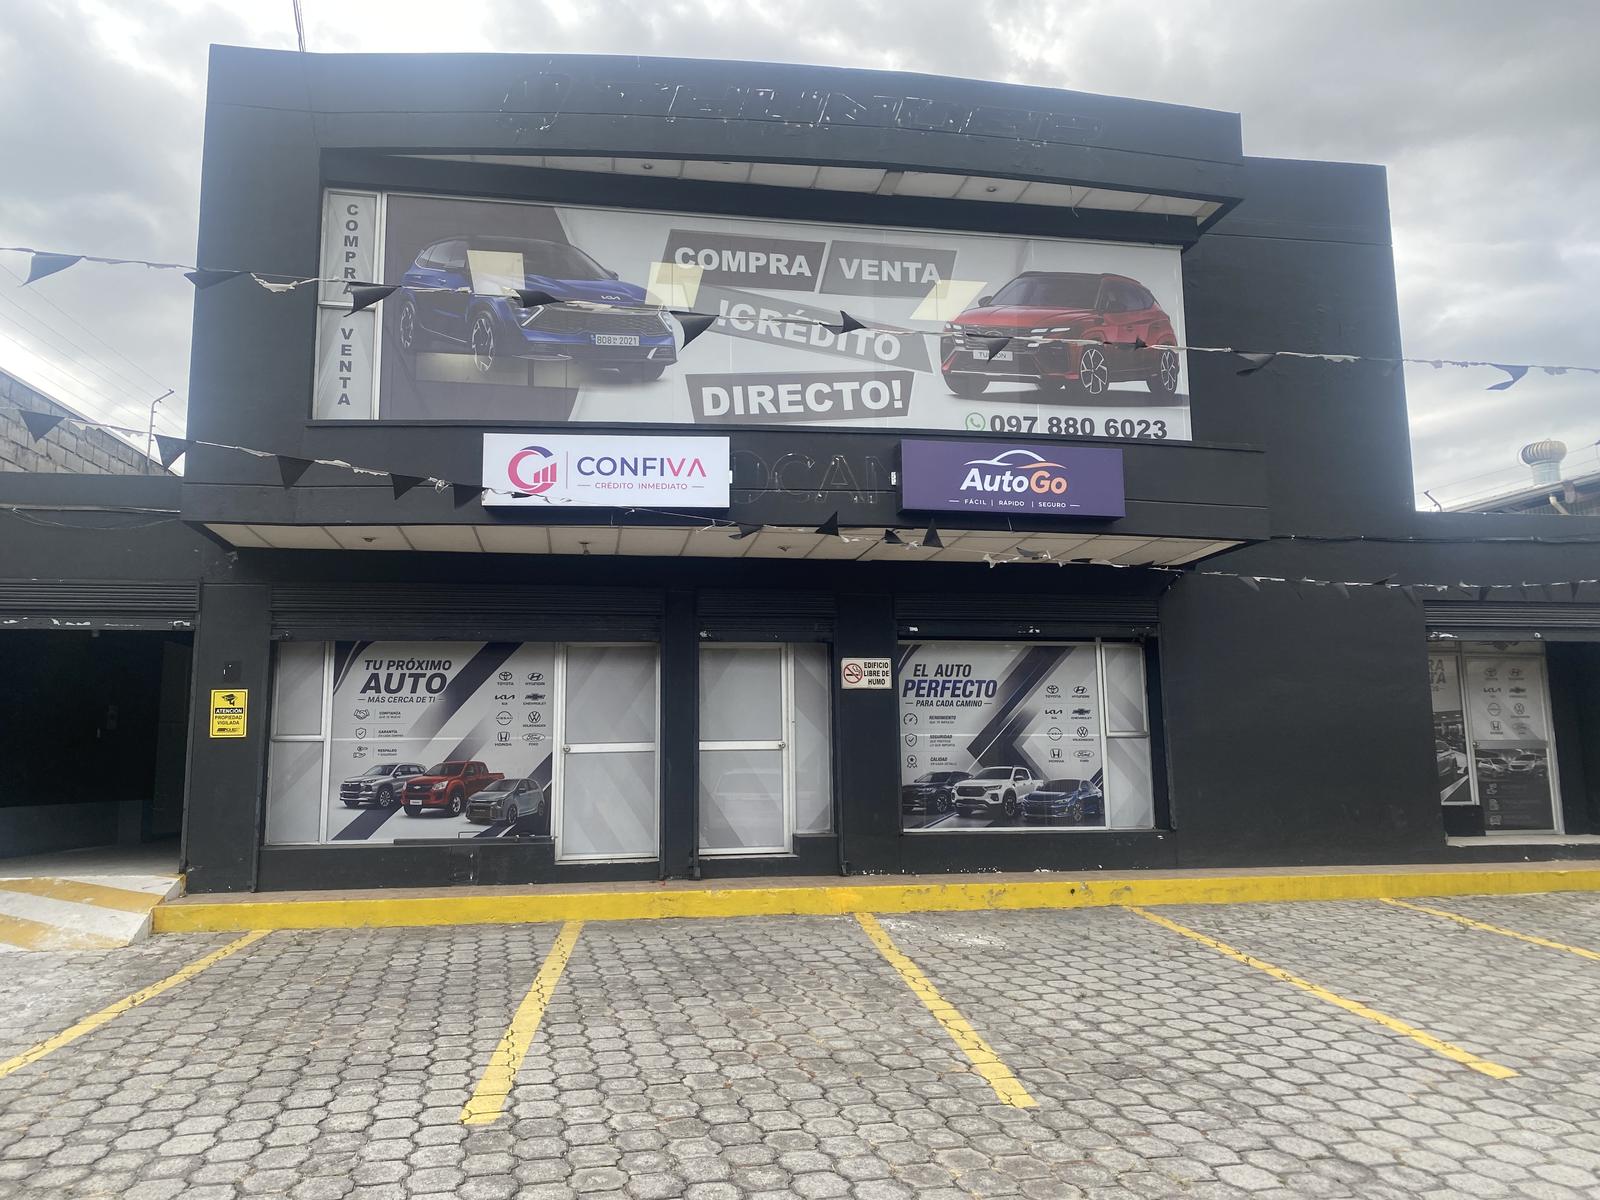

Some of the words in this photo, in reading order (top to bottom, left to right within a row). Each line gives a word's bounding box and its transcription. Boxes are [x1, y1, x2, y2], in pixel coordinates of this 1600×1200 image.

[674, 247, 812, 277] COMPRA
[838, 257, 940, 283] VENTA
[337, 328, 354, 405] VENTA
[702, 380, 903, 416] DIRECTO!
[990, 415, 1038, 434] 097
[1047, 417, 1095, 436] 880
[1104, 418, 1167, 439] 6023
[577, 456, 707, 477] CONFIVA
[594, 481, 634, 490] CRÉDITO
[638, 482, 688, 490] INMEDIATO
[960, 468, 1068, 494] AutoGo
[364, 660, 383, 670] TU
[386, 658, 452, 670] PRÓXIMO
[863, 661, 889, 669] EDIFICIO
[913, 664, 928, 677] EL
[934, 663, 972, 677] AUTO
[360, 672, 447, 694] AUTO
[902, 679, 998, 698] PERFECTO
[367, 695, 386, 703] MÁS
